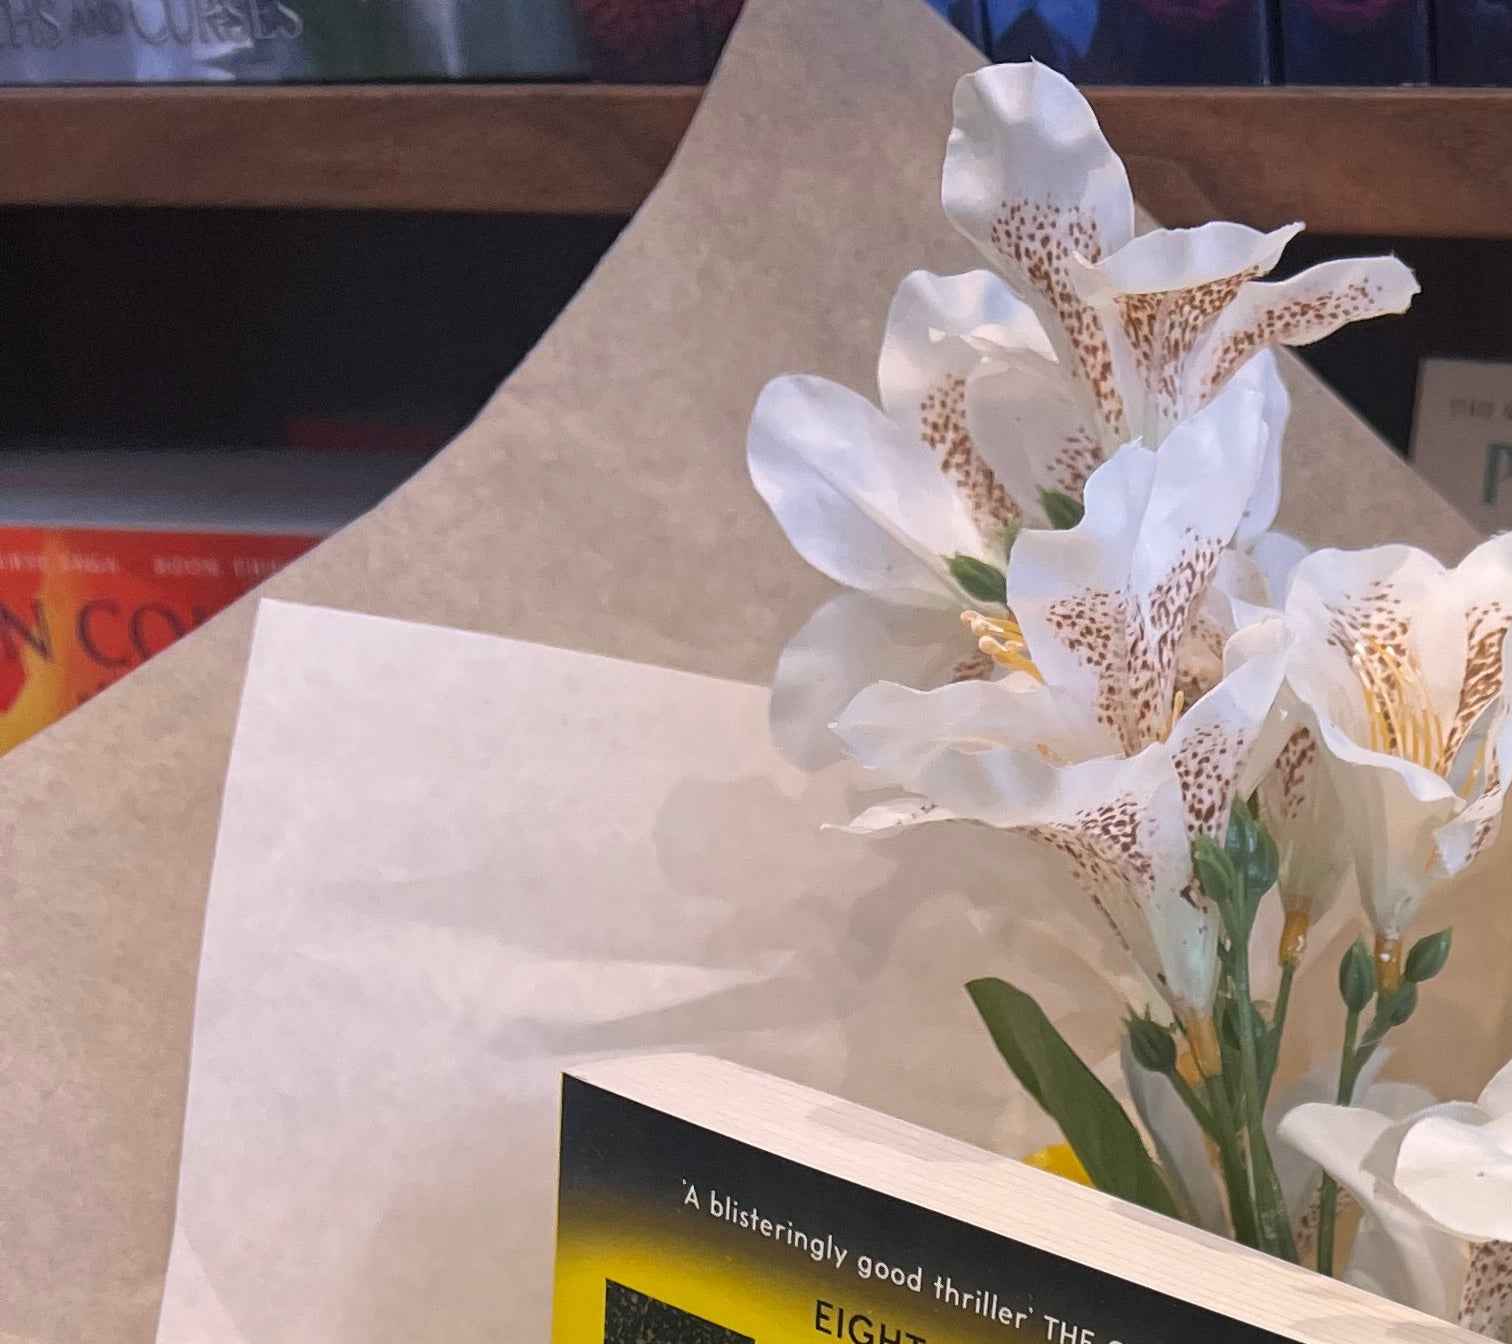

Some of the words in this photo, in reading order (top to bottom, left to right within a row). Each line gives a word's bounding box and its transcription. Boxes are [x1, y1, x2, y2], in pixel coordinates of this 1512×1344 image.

[75, 598, 207, 672] CO
[709, 1190, 848, 1269] blisteringly
[857, 1255, 923, 1293] good
